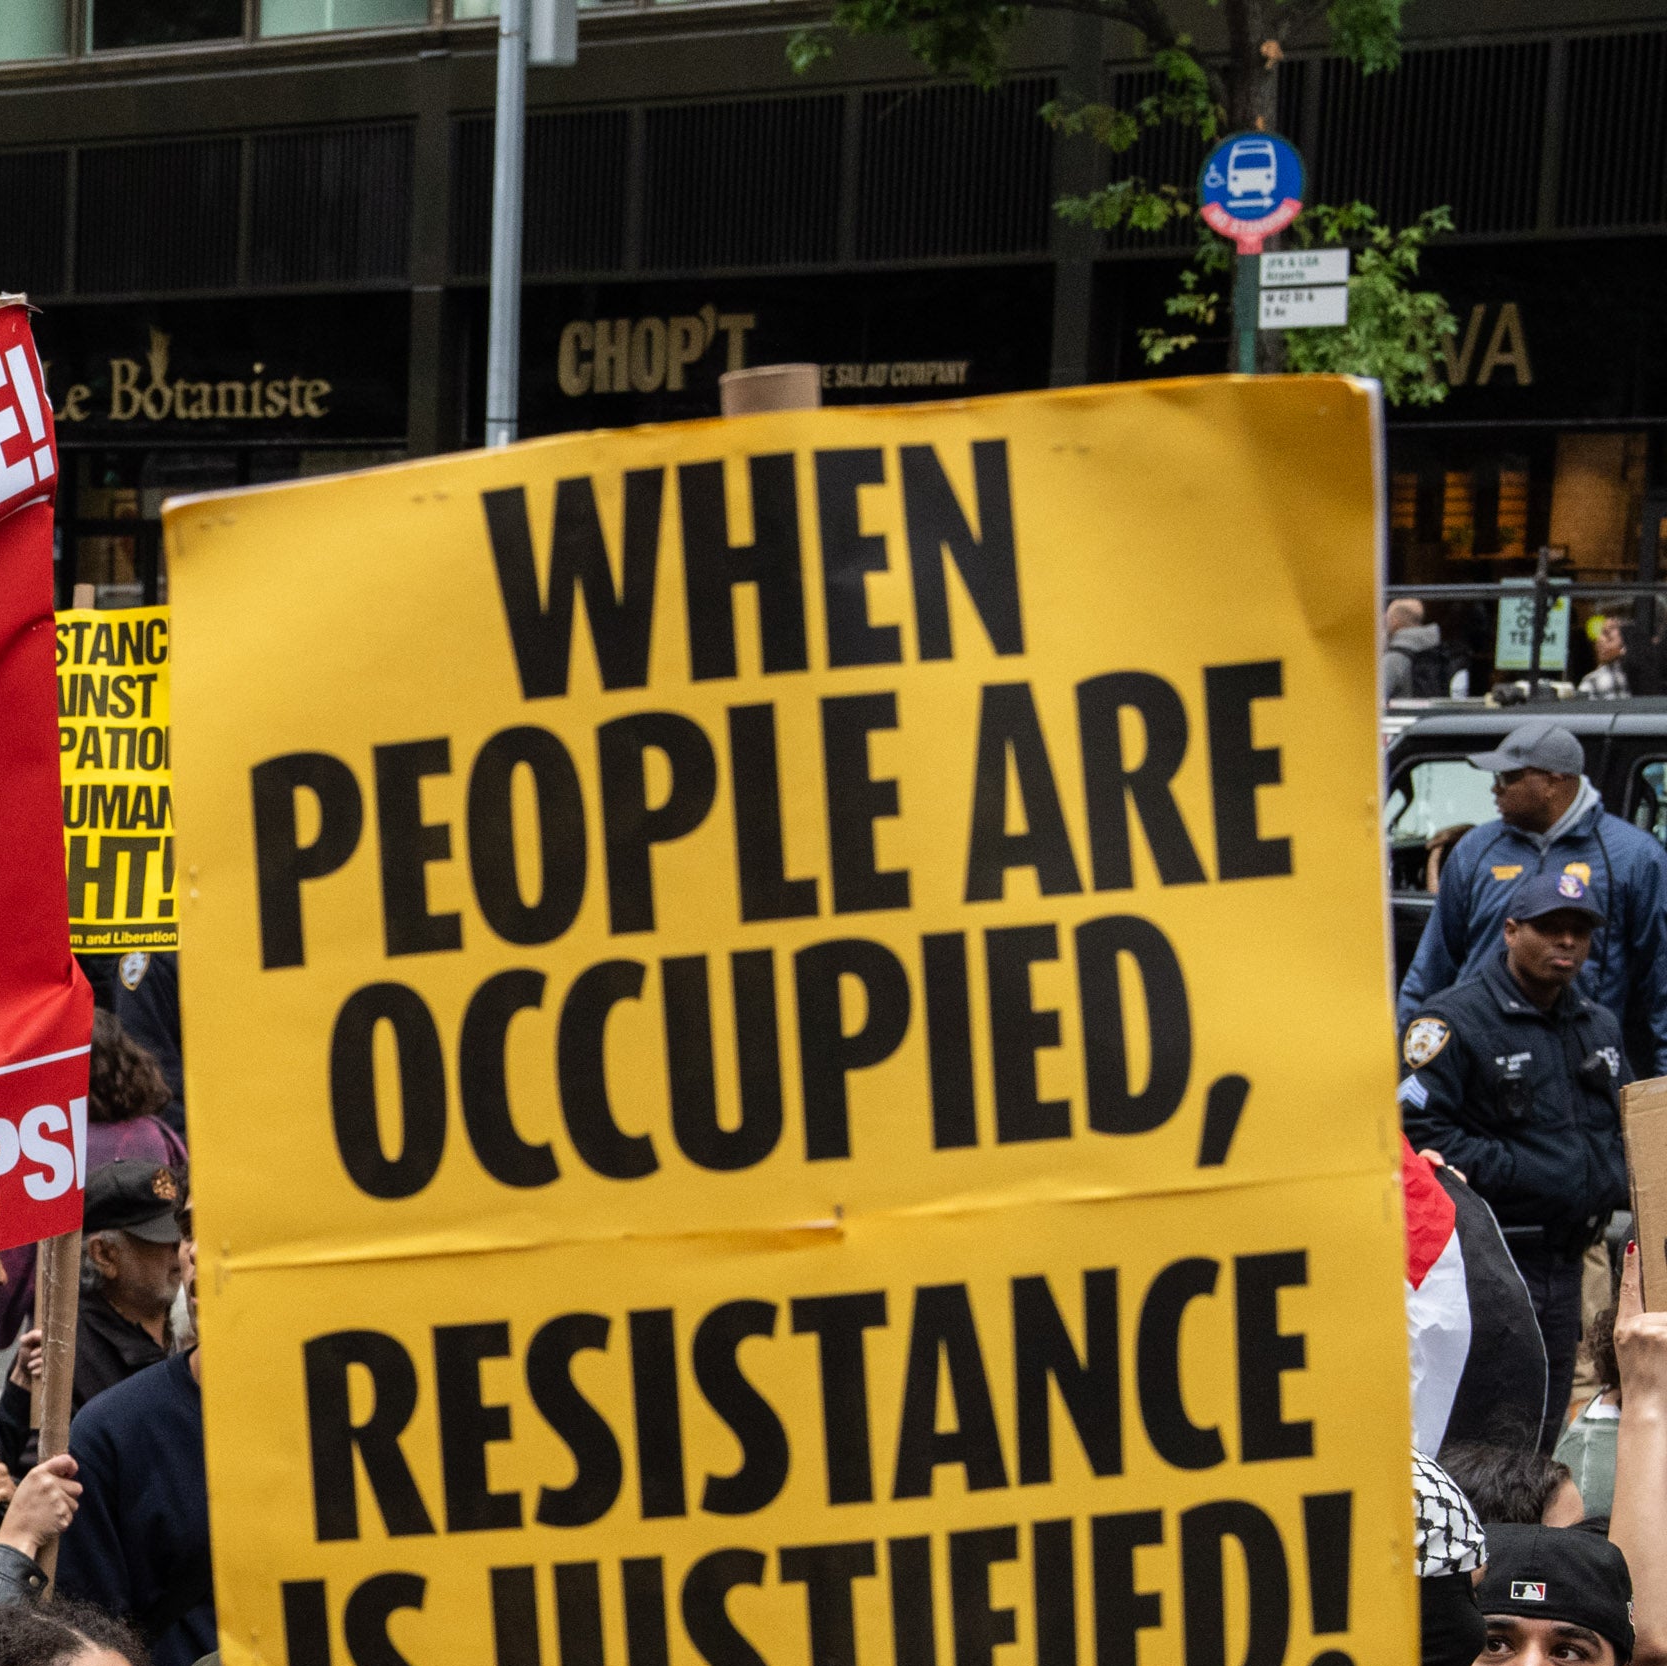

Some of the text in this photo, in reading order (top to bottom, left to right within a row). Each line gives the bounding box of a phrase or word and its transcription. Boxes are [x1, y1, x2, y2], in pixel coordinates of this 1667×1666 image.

[107, 346, 333, 422] Botaniste
[557, 303, 756, 398] CHOP'T
[481, 437, 1025, 701] WHEN
[55, 618, 172, 668] STANC
[59, 726, 171, 772] PATIO
[248, 657, 1294, 972] PEOPLE ARE
[86, 932, 111, 946] and
[113, 931, 177, 945] Liberation
[328, 914, 1253, 1201] OCCUPIED,
[301, 1247, 1316, 1543] RESISTANCE
